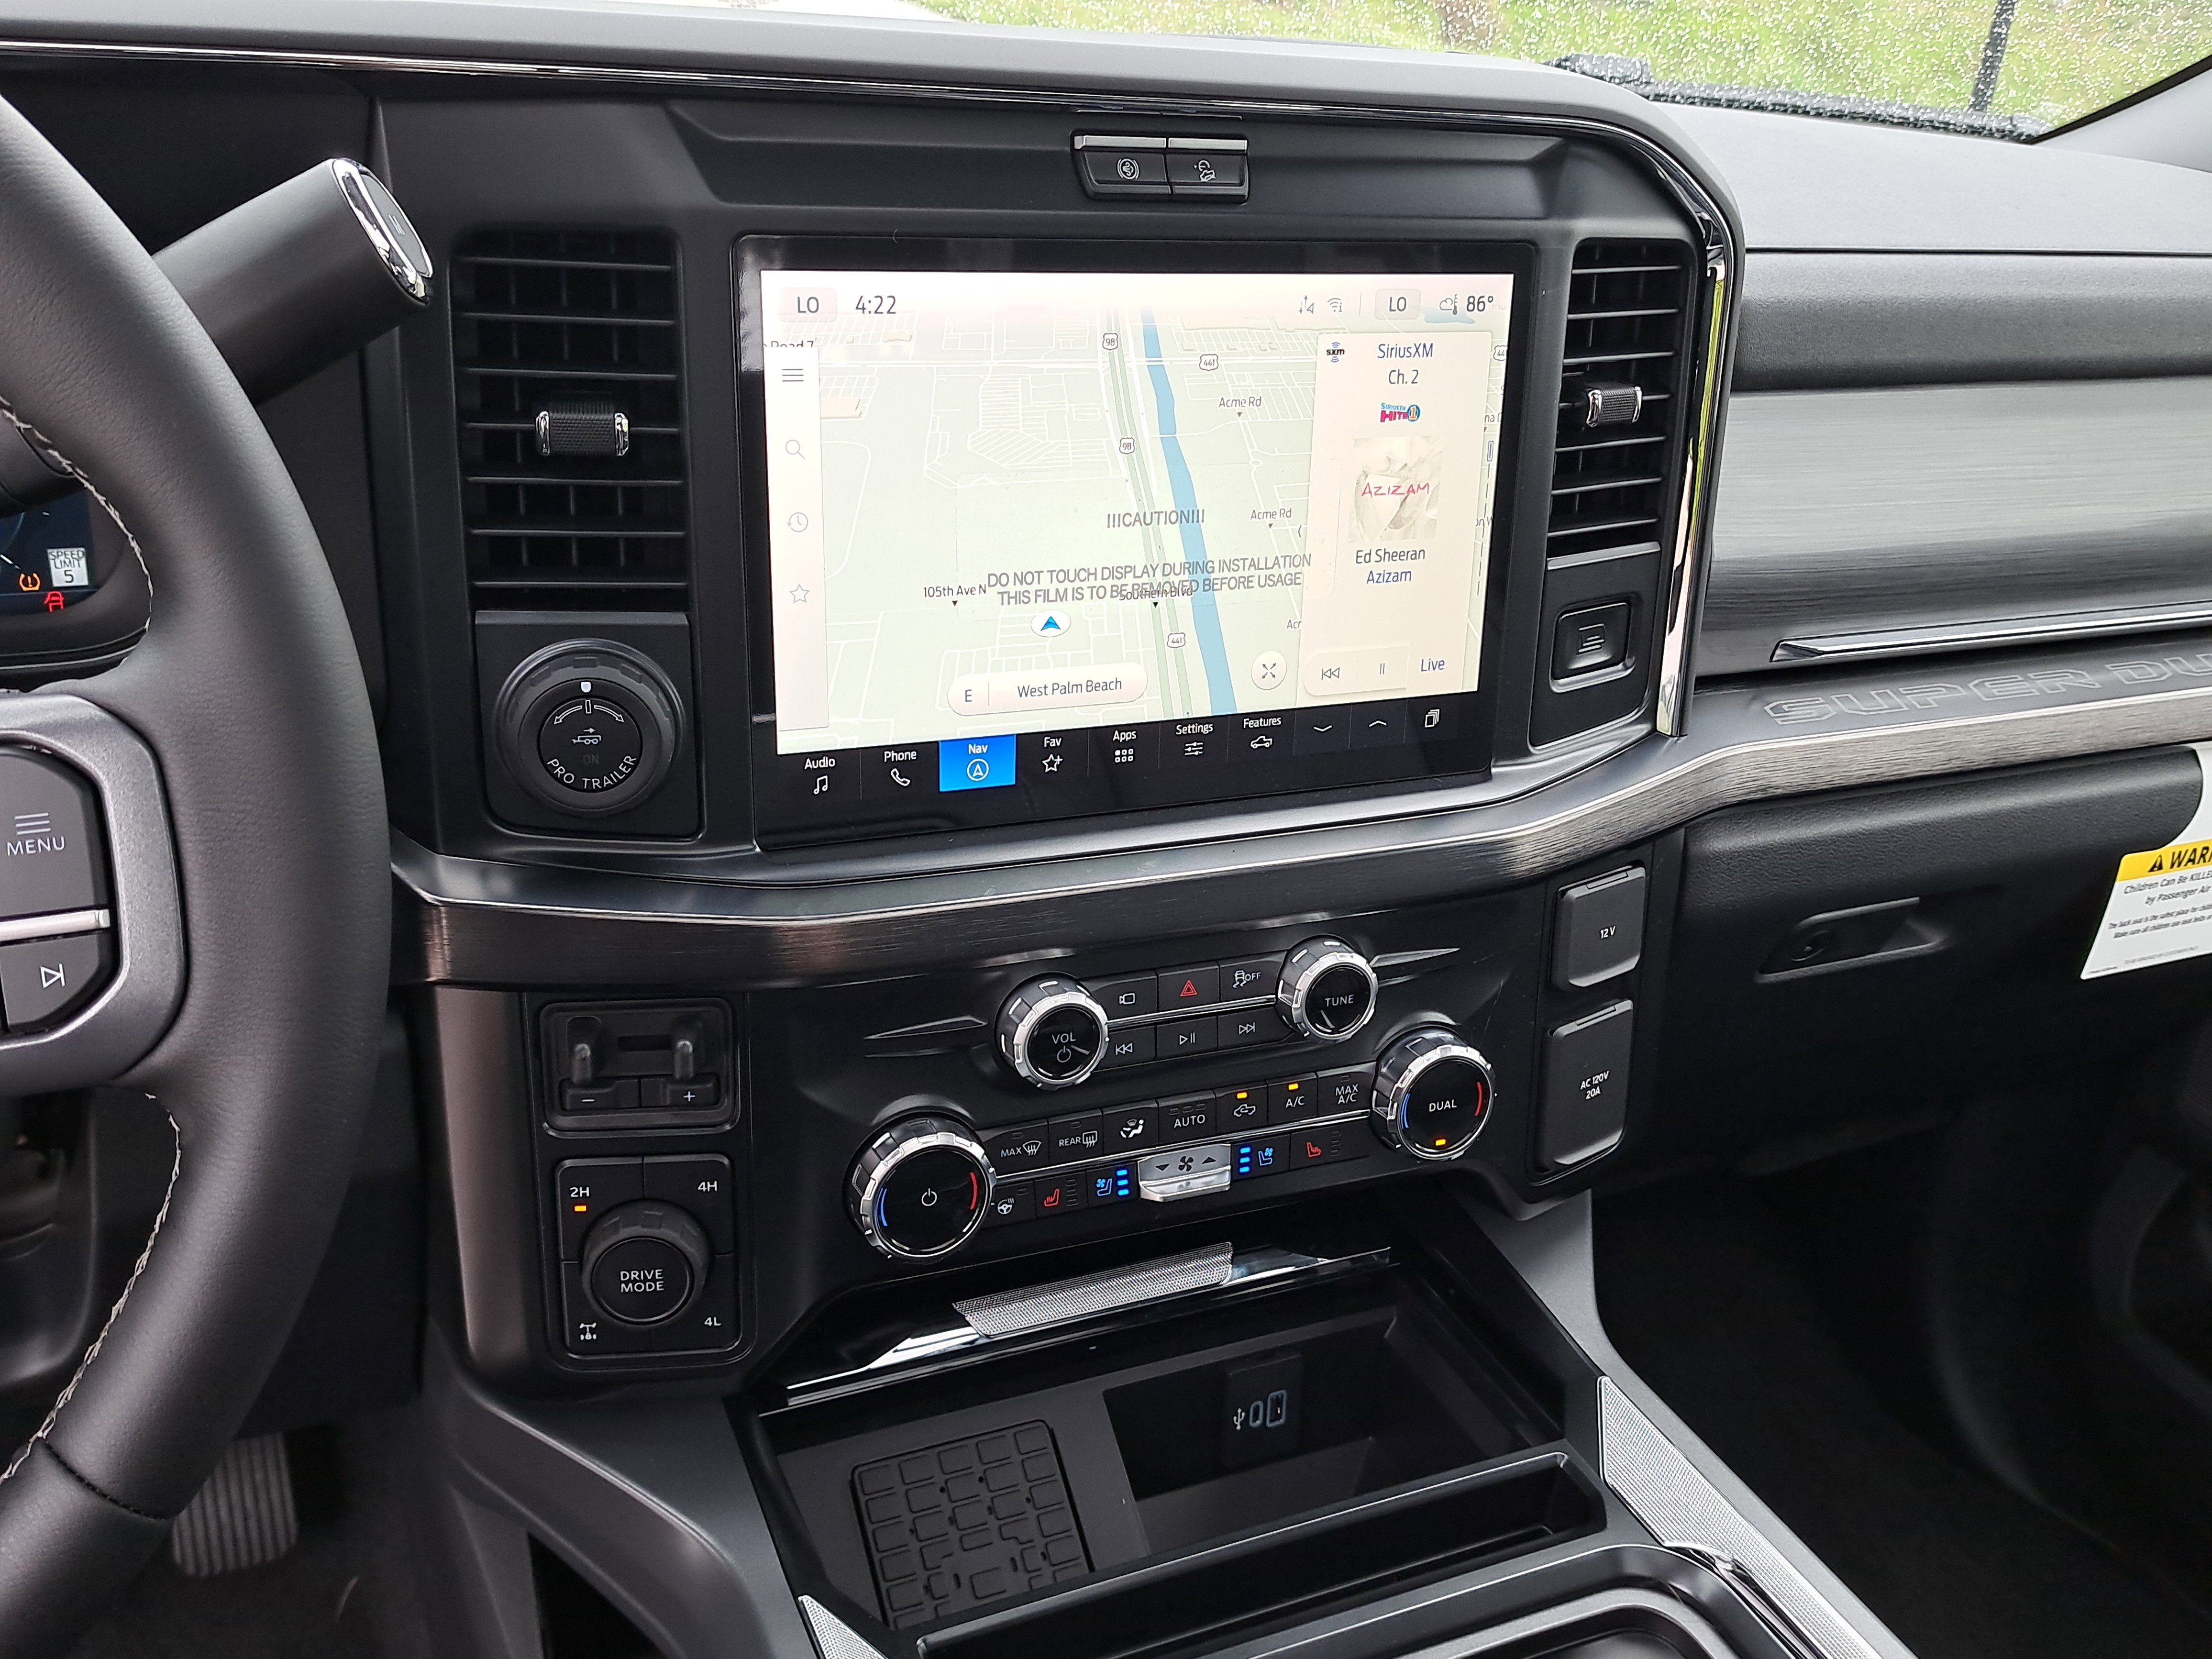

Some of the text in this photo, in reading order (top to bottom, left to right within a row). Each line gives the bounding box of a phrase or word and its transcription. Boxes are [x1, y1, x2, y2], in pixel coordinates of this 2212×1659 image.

[796, 296, 819, 314] LO
[855, 295, 897, 315] 4:22
[1388, 297, 1407, 312] LO
[1466, 295, 1493, 312] 86°
[1106, 337, 1115, 346] 98
[1377, 343, 1433, 358] SiriusXM
[1388, 369, 1419, 385] Ch. 2
[1218, 396, 1261, 408] Acme Rd
[1122, 442, 1132, 451] 98
[1361, 482, 1430, 498] AZIZAM
[1250, 508, 1292, 520] Acme Rd
[49, 550, 84, 561] SPEED
[1355, 548, 1426, 564] Ed Sheeran
[54, 560, 80, 569] LIMIT
[987, 554, 1311, 587] DO NOT TOUCH DISPLAY DURING INSTALLATION
[64, 569, 74, 584] 5
[1366, 569, 1412, 584] Azizam
[923, 584, 986, 598] 105th Ave N
[997, 571, 1303, 606] THIS FILM IS TO BE REMOVED BEFORE USAGE
[1421, 658, 1445, 672] Live
[1018, 677, 1122, 698] West Palm Beach
[965, 689, 972, 702] E
[1763, 669, 2102, 726] SUPER
[1175, 721, 1214, 736] Settings
[1243, 717, 1282, 729] Features
[1113, 730, 1137, 741] Apps
[968, 744, 988, 754] Nav
[1044, 737, 1062, 748] Fav
[884, 750, 917, 762] Phone
[804, 756, 836, 770] Audio
[547, 755, 637, 789] PRO TRAILER
[7, 836, 66, 857] MENU
[2124, 882, 2158, 894] Children
[2160, 879, 2175, 887] Can
[2157, 888, 2198, 902] Passenger
[1245, 971, 1261, 982] OFF
[1325, 995, 1354, 1007] TUNE
[1052, 1031, 1076, 1044] VOL
[1580, 1070, 1610, 1090] AC 120V
[1335, 1084, 1358, 1095] MAX
[1586, 1086, 1601, 1099] 20A
[1285, 1095, 1305, 1108] A/C
[1338, 1092, 1357, 1105] A/C
[1428, 1100, 1458, 1112] DUAL
[1173, 1114, 1206, 1128] AUTO
[1058, 1136, 1081, 1148] REAR
[1000, 1146, 1022, 1157] MAX
[570, 1186, 590, 1198] 2H
[697, 1181, 718, 1192] 4H
[620, 1269, 664, 1281] DRIVE
[620, 1281, 664, 1293] MODE
[704, 1316, 721, 1327] 4L
